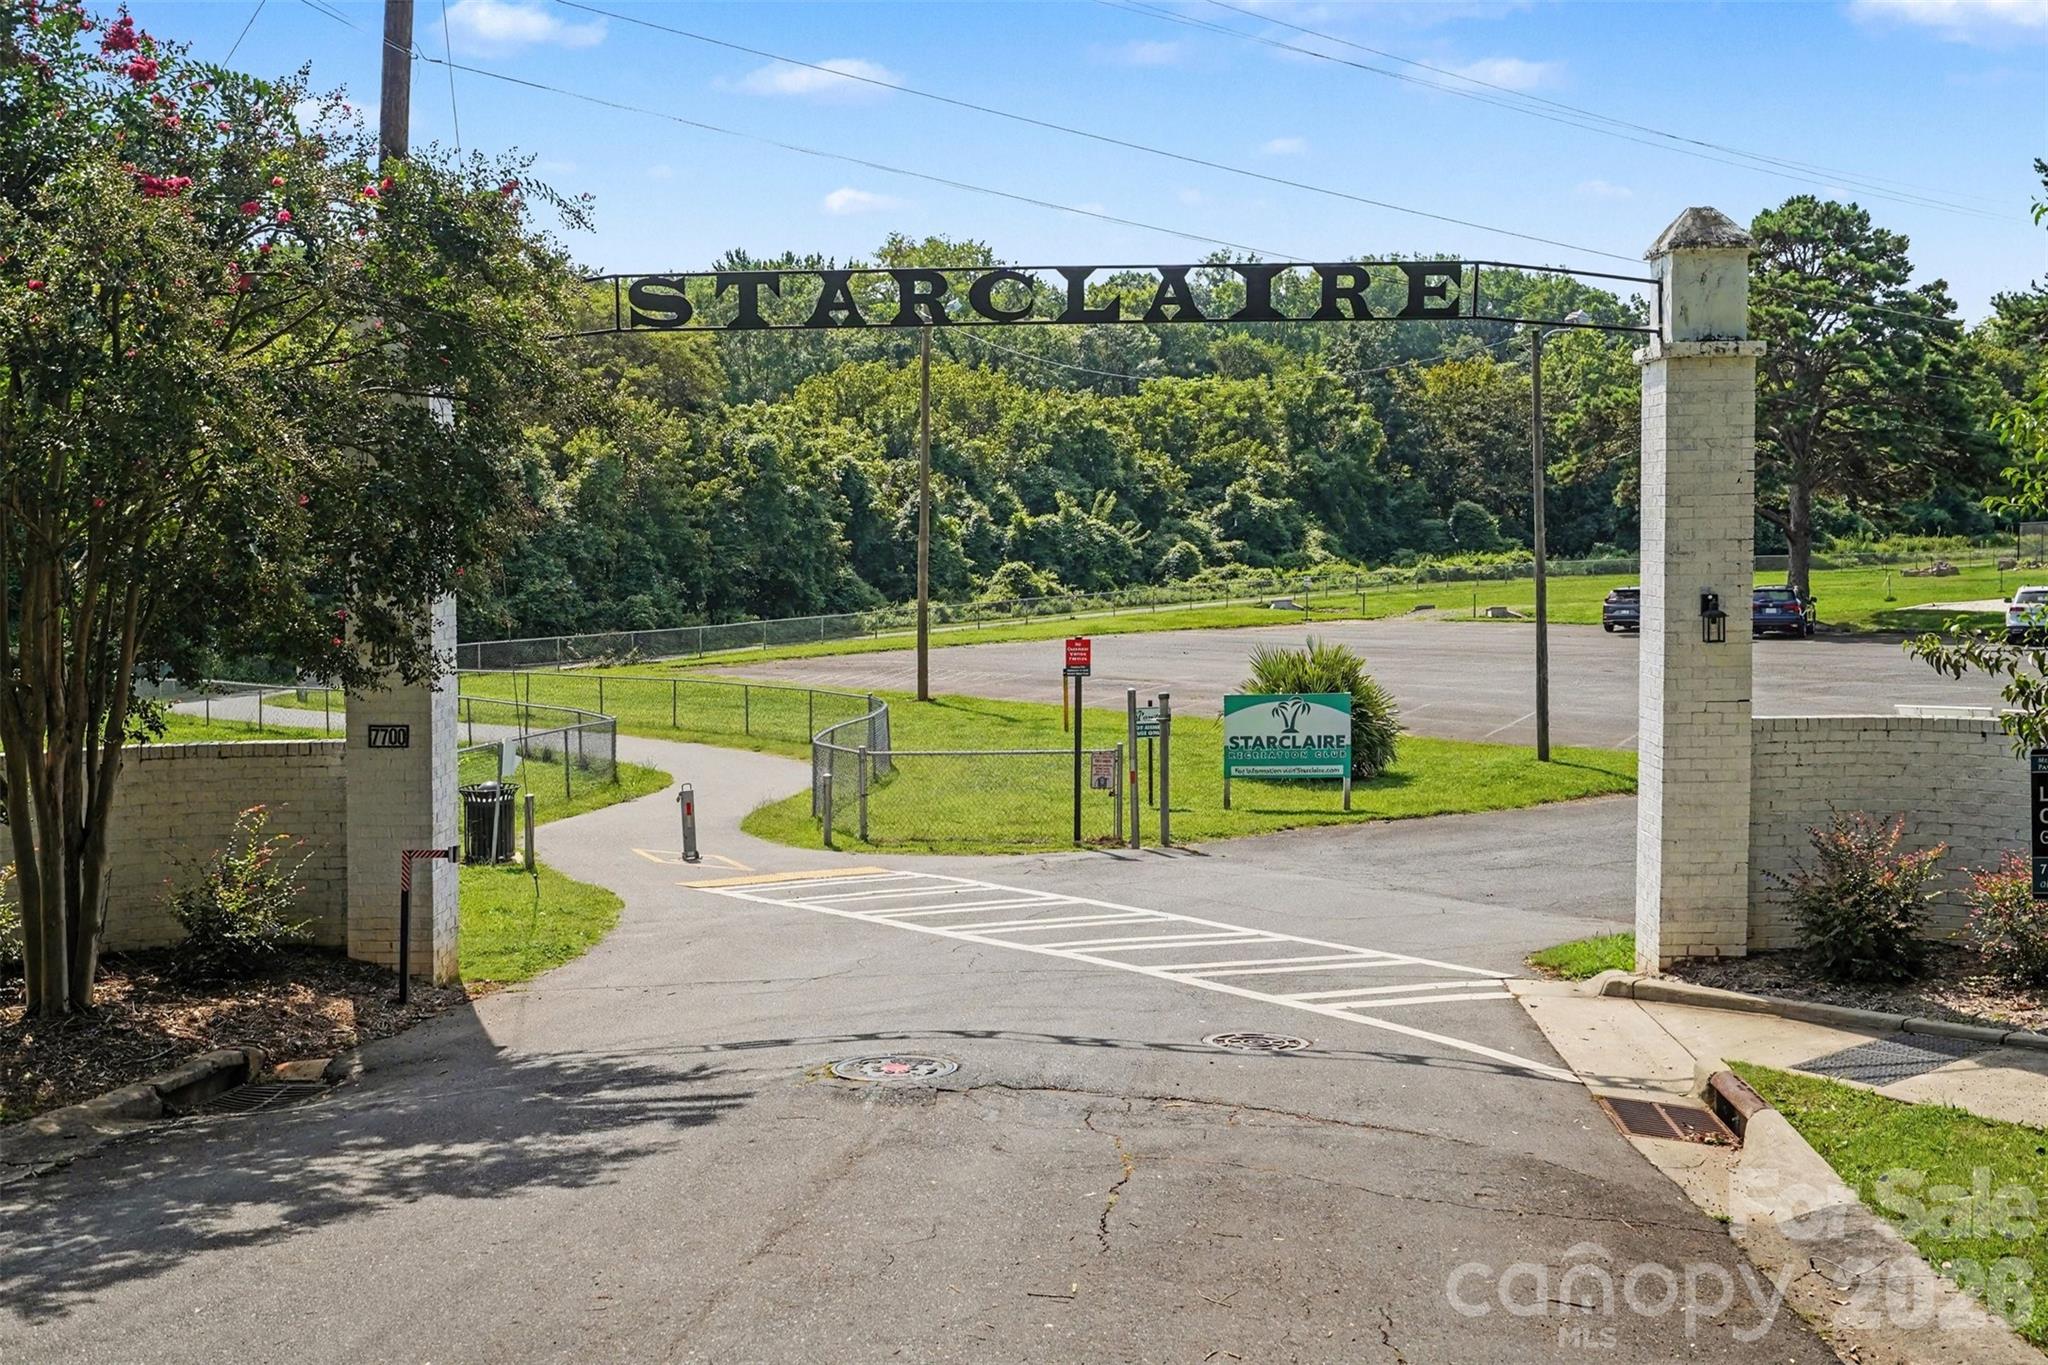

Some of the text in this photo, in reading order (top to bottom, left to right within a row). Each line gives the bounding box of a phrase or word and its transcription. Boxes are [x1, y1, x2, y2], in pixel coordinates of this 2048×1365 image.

[629, 262, 1461, 329] STARCLAIRE
[371, 728, 406, 745] 7700
[1229, 735, 1346, 750] STARCLAIRE
[1229, 750, 1347, 760] RECREATION CLUB
